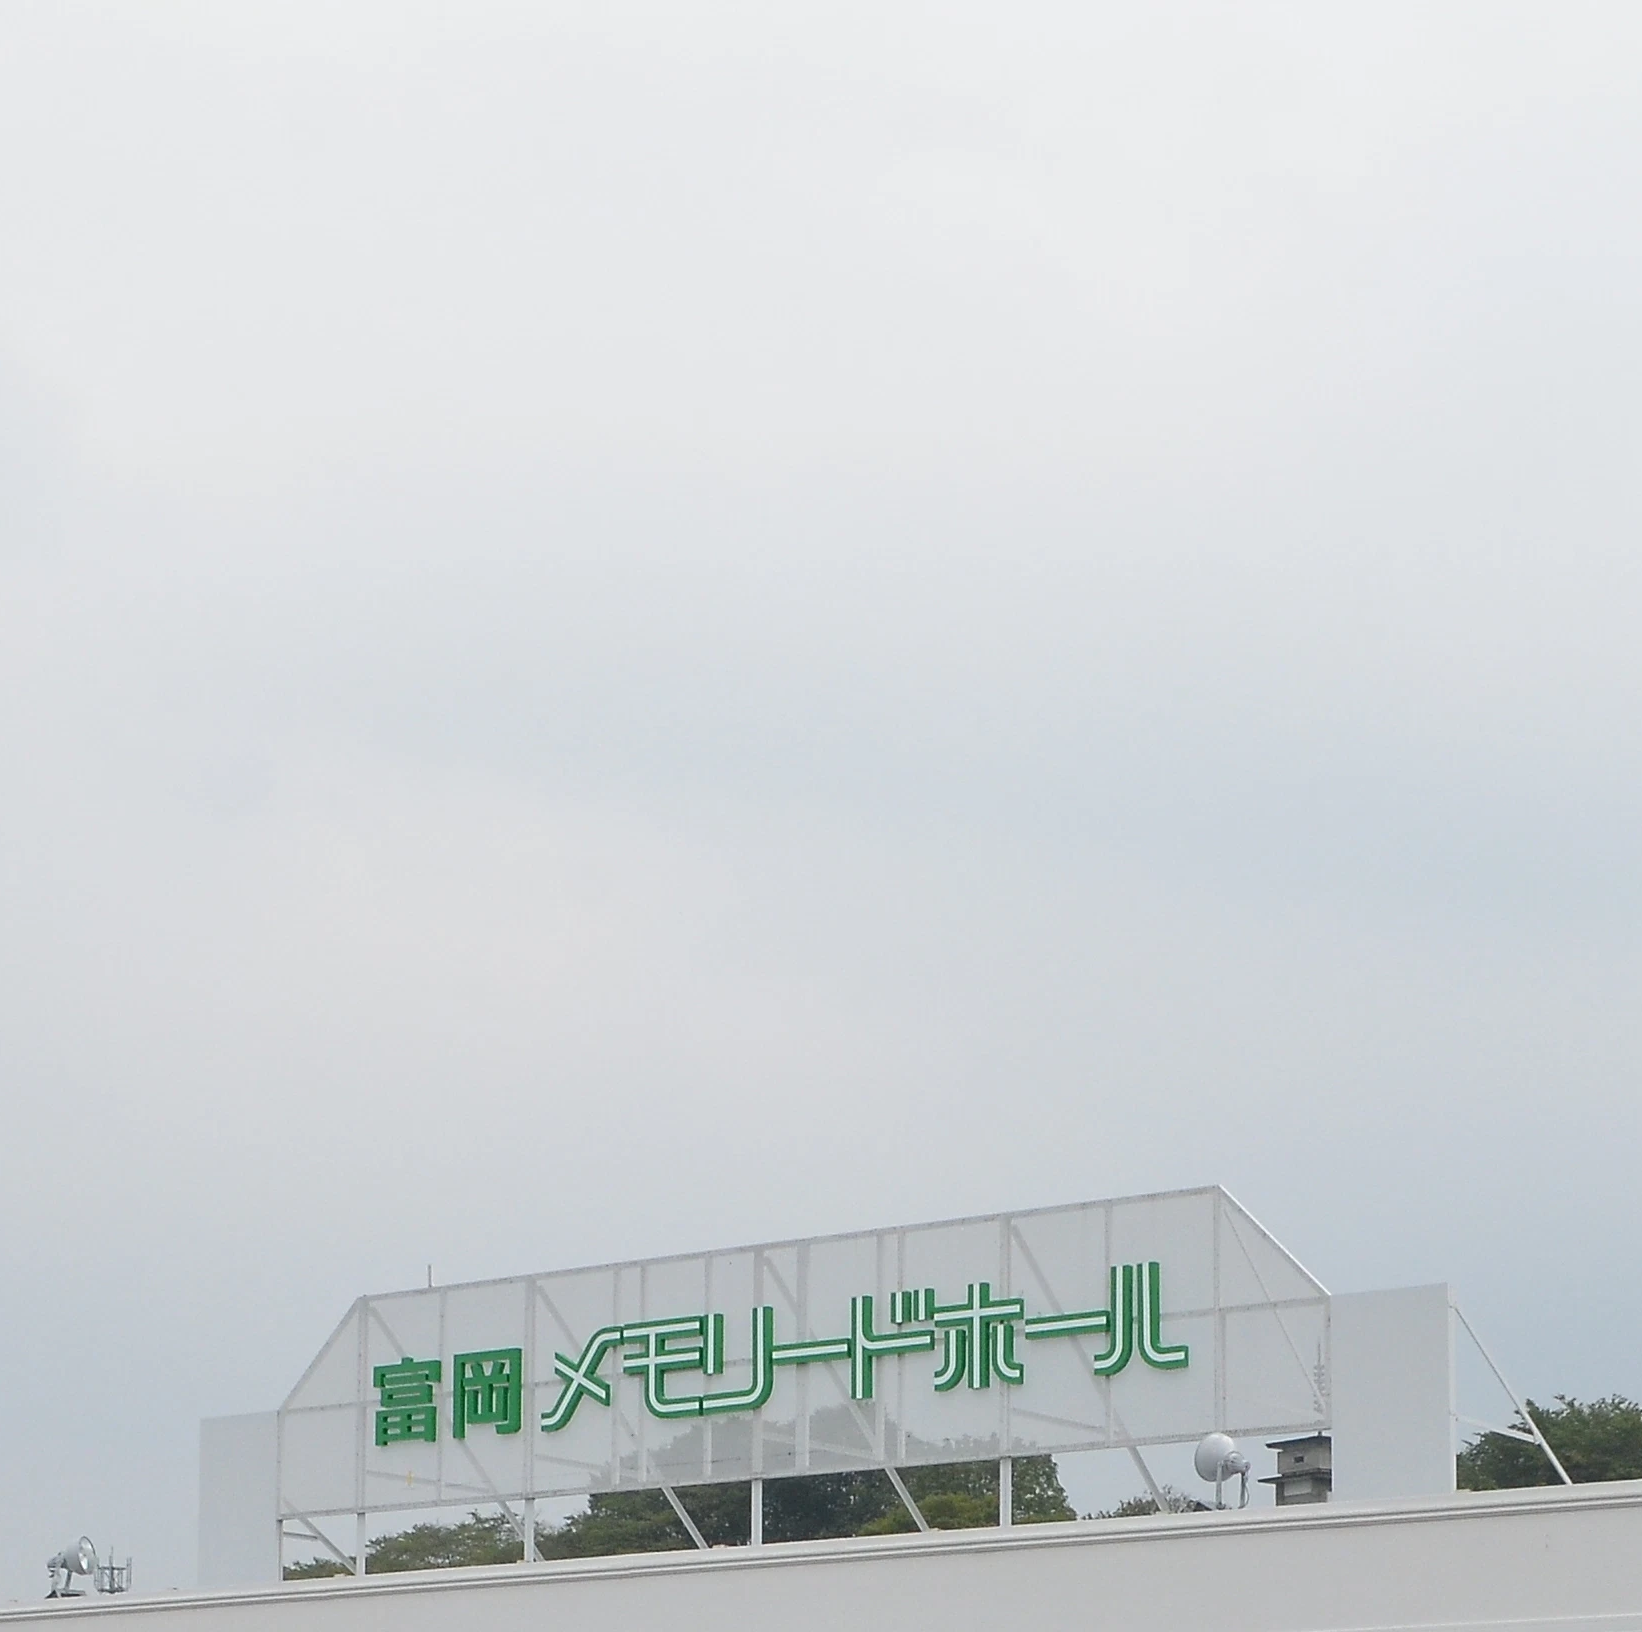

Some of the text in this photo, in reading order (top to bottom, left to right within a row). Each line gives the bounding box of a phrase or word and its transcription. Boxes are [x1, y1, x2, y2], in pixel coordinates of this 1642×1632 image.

[373, 1262, 1189, 1446] 富岡メモリードホール
